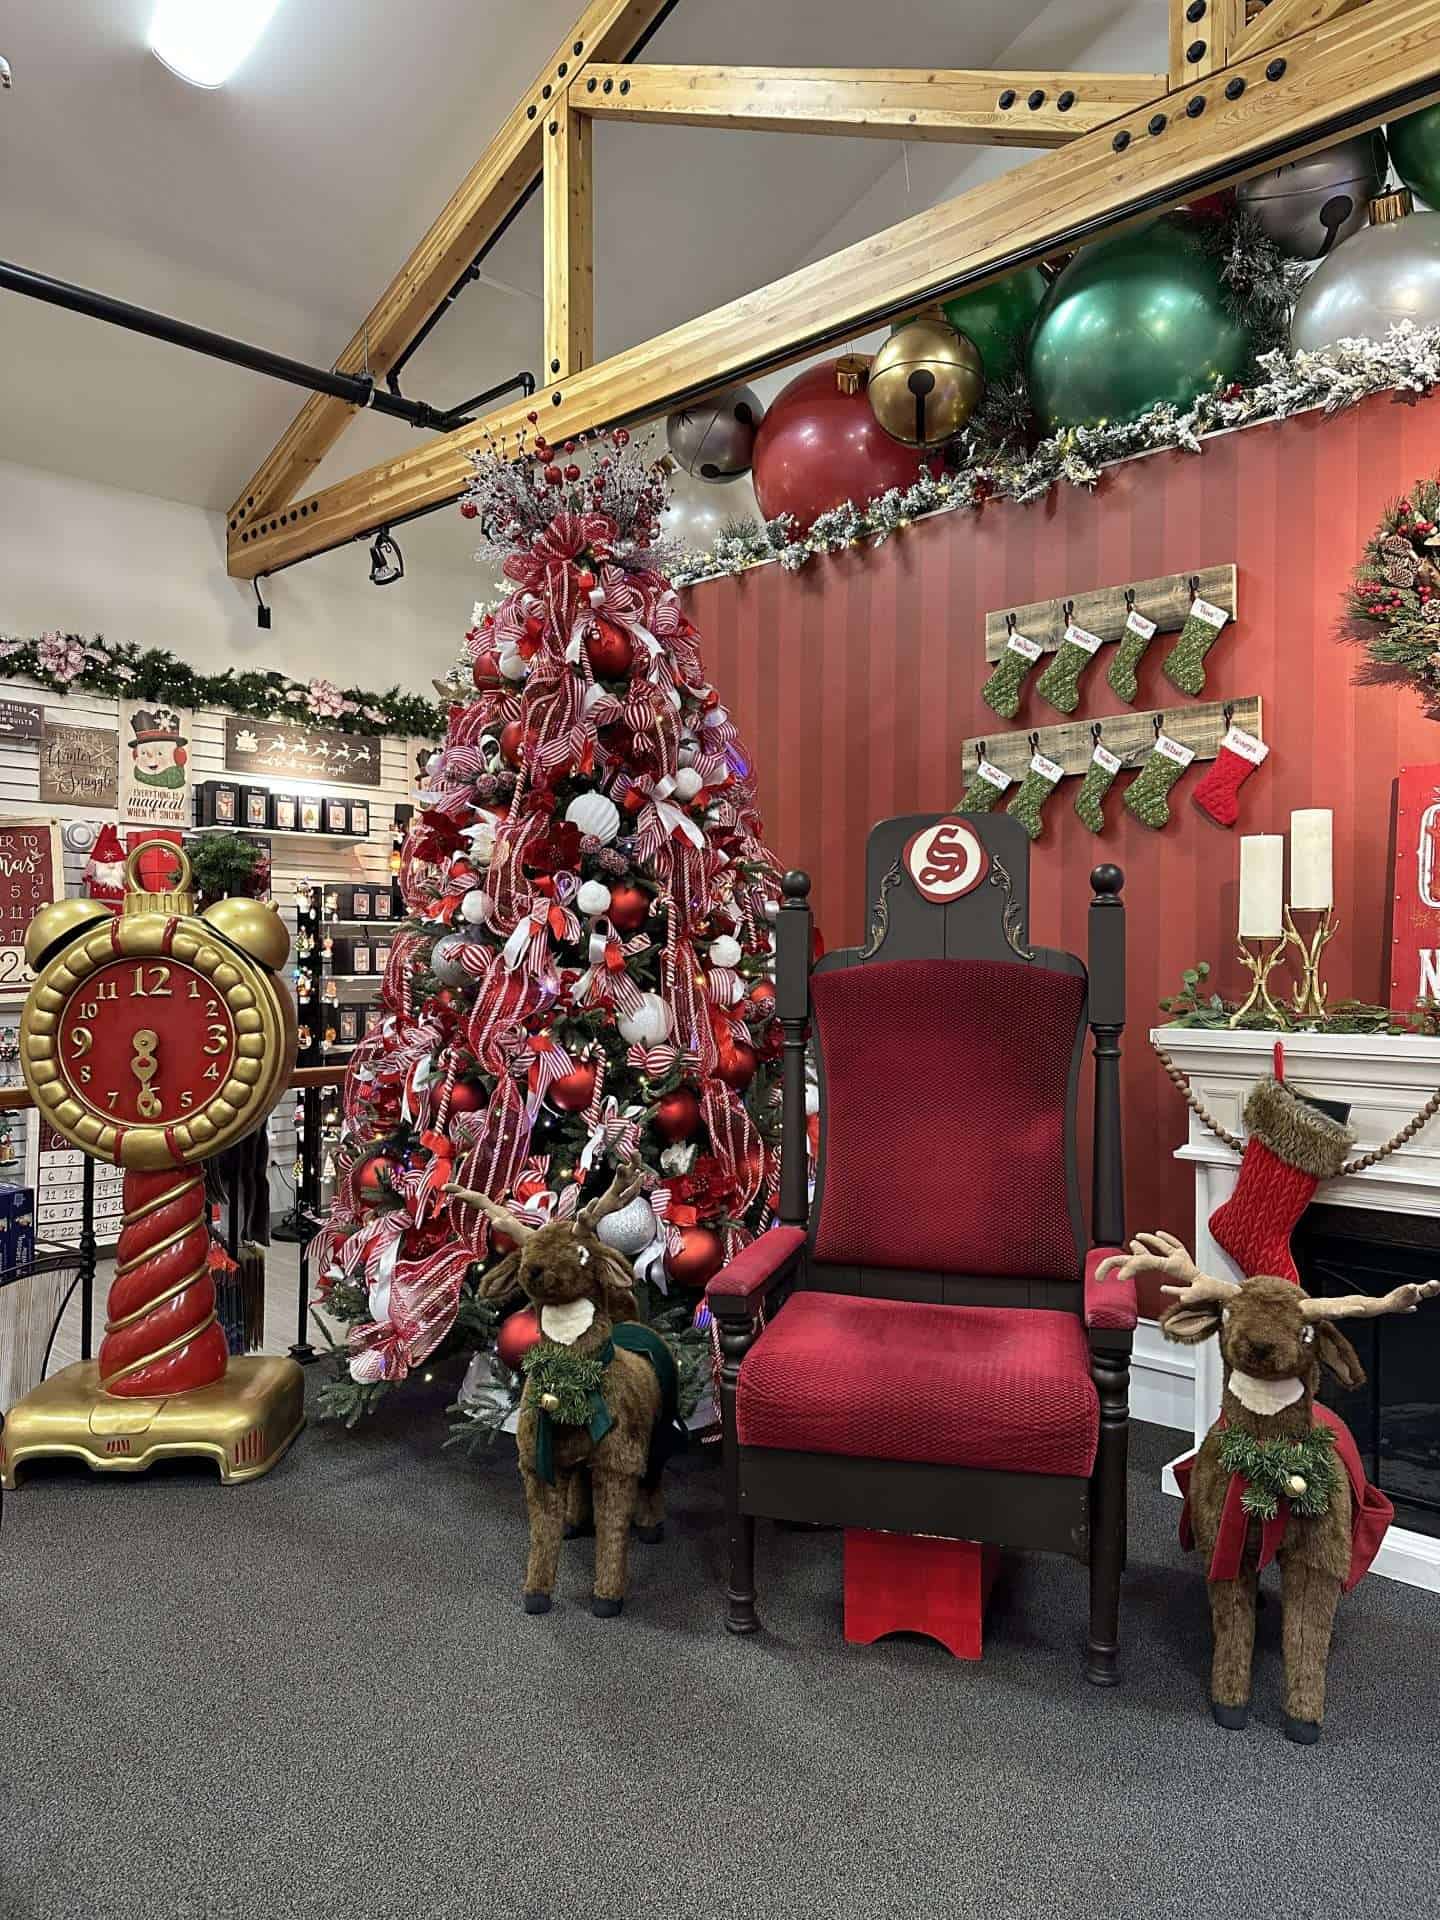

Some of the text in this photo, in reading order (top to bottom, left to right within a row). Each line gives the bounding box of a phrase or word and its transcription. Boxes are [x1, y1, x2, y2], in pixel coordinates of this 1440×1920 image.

[128, 794, 184, 812] magical
[127, 807, 147, 817] WHEN
[160, 810, 184, 820] SNOWS
[20, 835, 38, 847] TO
[10, 885, 40, 898] 5 6
[9, 906, 24, 919] 11
[10, 929, 24, 943] 17
[128, 965, 173, 997] 12
[187, 980, 201, 998] 1
[96, 982, 119, 1000] 11
[78, 1003, 98, 1019] 10
[205, 1000, 219, 1017] 2
[71, 1027, 93, 1059] 9
[203, 1024, 228, 1054] 3
[80, 1066, 91, 1083] 8
[203, 1062, 220, 1080] 4
[107, 1091, 119, 1109] 7
[180, 1091, 193, 1108] 5
[48, 1173, 55, 1182] 6
[43, 1208, 56, 1219] 16
[62, 1208, 75, 1218] 17
[61, 1226, 75, 1236] 22
